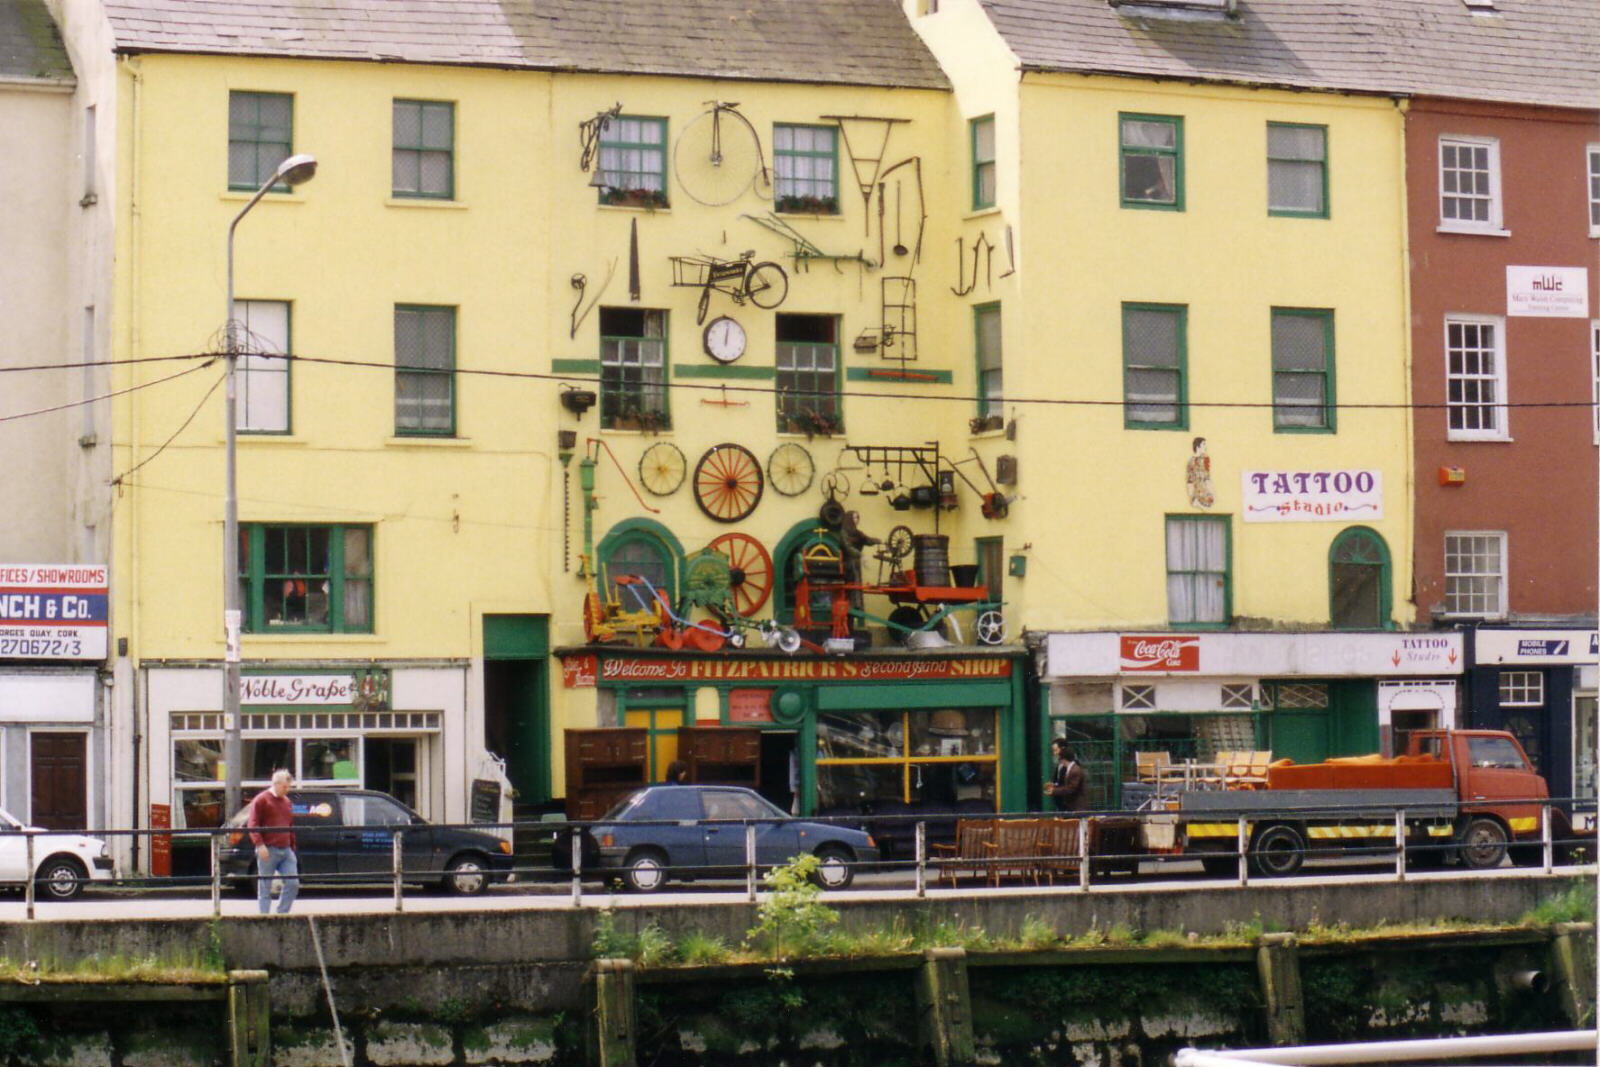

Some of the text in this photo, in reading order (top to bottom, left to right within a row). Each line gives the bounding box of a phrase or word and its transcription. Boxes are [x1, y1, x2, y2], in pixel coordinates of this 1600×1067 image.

[1251, 471, 1374, 494] TATTOO
[1280, 500, 1343, 516] studio
[0, 594, 40, 619] NCH
[45, 599, 58, 619] &
[0, 639, 82, 656] 270672/3
[1134, 640, 1181, 659] Coca-Cola
[1402, 639, 1448, 649] TATTOO
[1520, 640, 1547, 648] MOBILE
[1407, 651, 1441, 662] Studio
[602, 658, 667, 677] Welcome
[690, 660, 857, 678] FITZPATRICKS
[951, 659, 1007, 676] SHOP
[239, 677, 347, 702] Noble Grape
